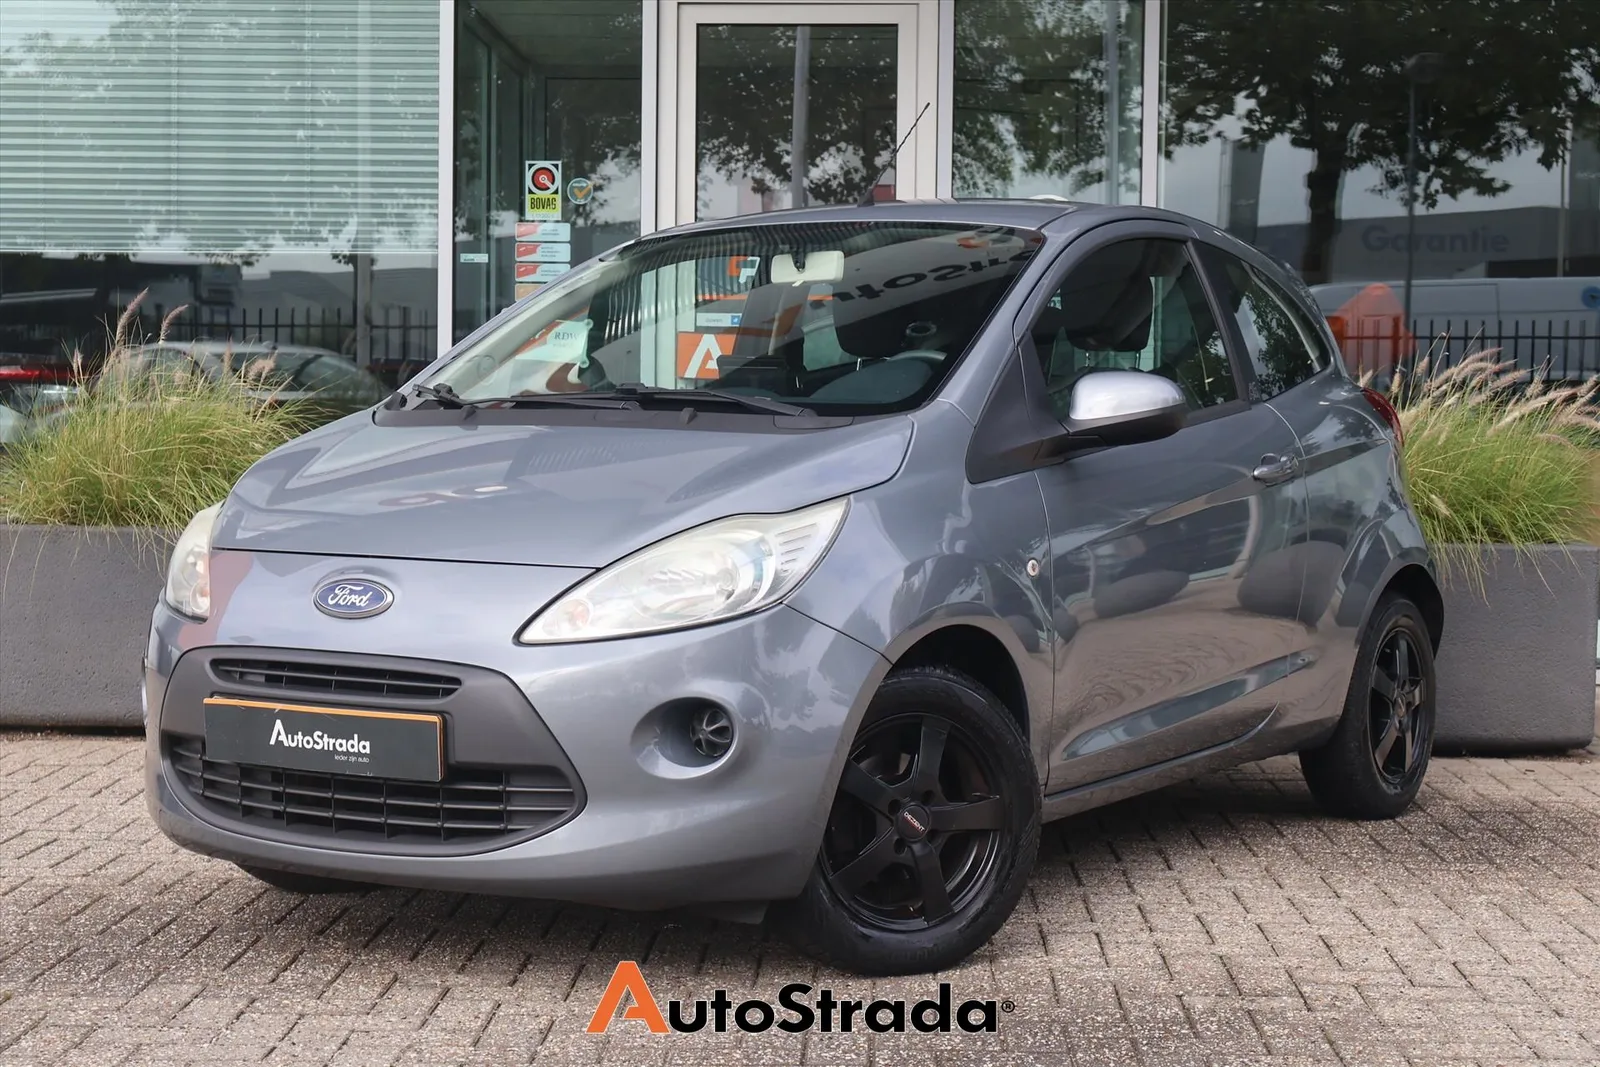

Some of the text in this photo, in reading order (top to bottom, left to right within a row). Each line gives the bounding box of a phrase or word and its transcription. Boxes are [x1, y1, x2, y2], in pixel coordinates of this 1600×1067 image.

[530, 197, 557, 210] BOVAG
[1361, 224, 1509, 253] Garantie
[327, 584, 373, 607] Ford
[269, 718, 371, 754] AutoStrada
